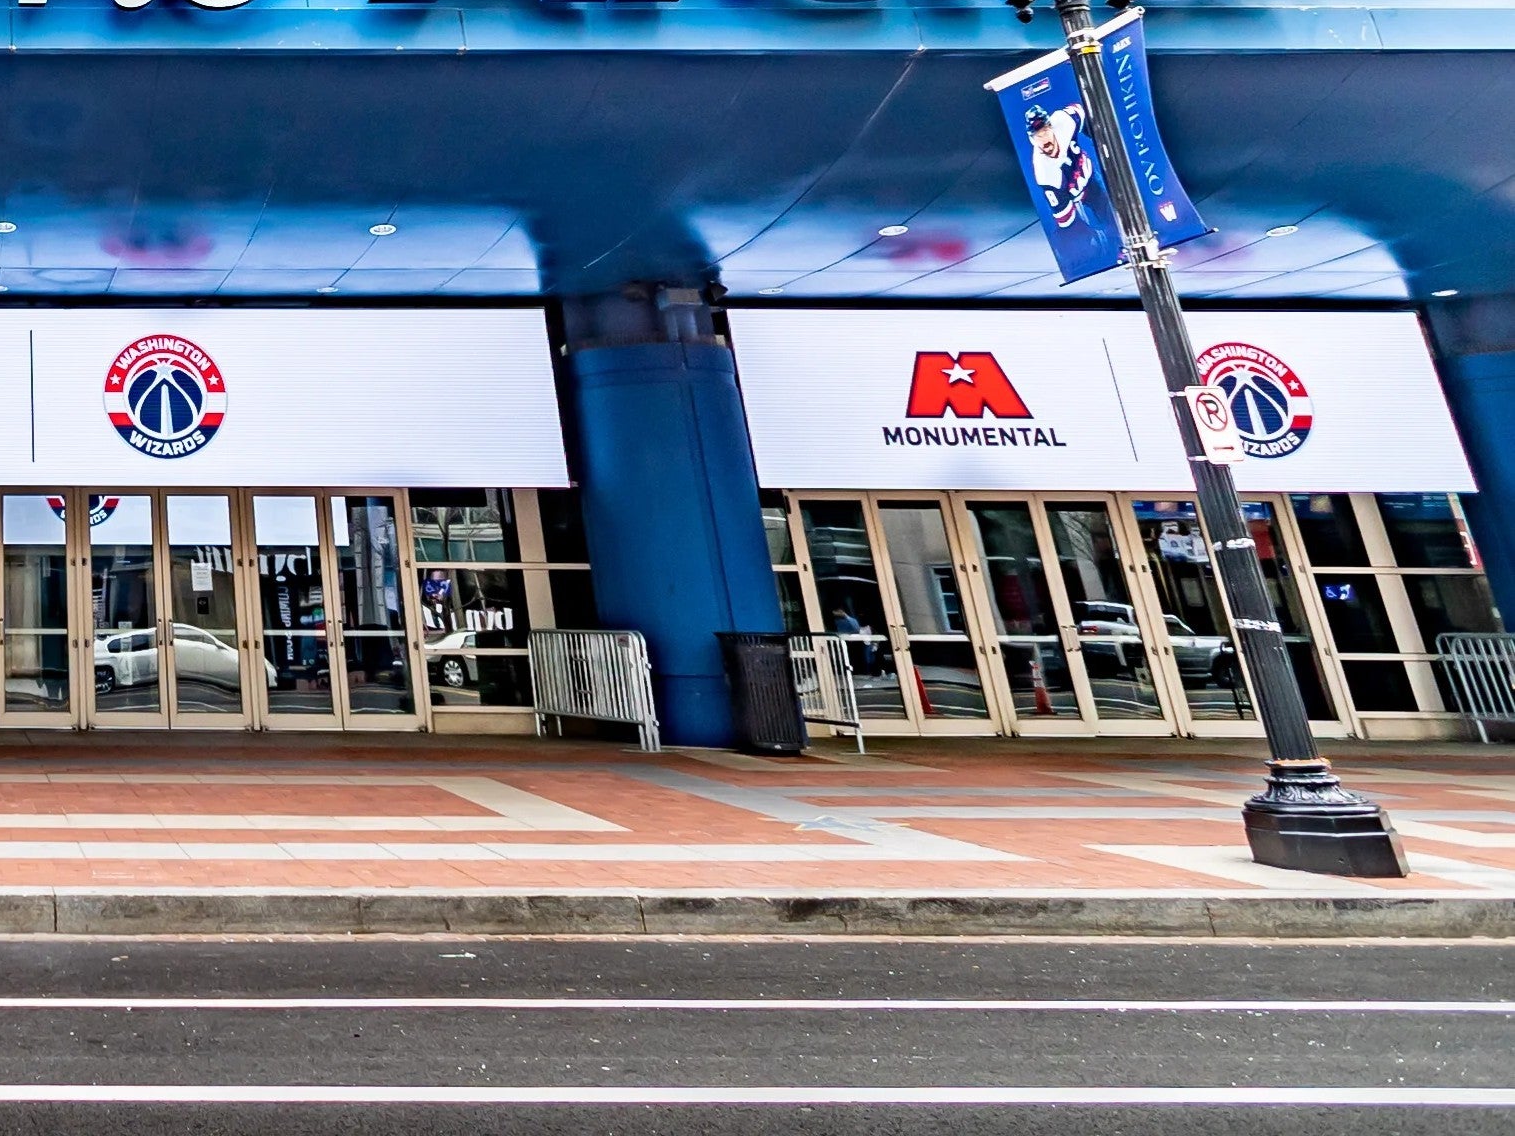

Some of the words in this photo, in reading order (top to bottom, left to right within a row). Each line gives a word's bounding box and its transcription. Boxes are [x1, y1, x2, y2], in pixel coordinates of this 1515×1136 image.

[1115, 53, 1165, 196] OVECHKIN
[115, 337, 212, 372] WASHINGTON
[1196, 345, 1288, 377] WASHINGTON
[129, 430, 206, 456] WIZARDS
[883, 426, 1067, 449] MONUMENTAL
[1242, 432, 1301, 455] IZARDS
